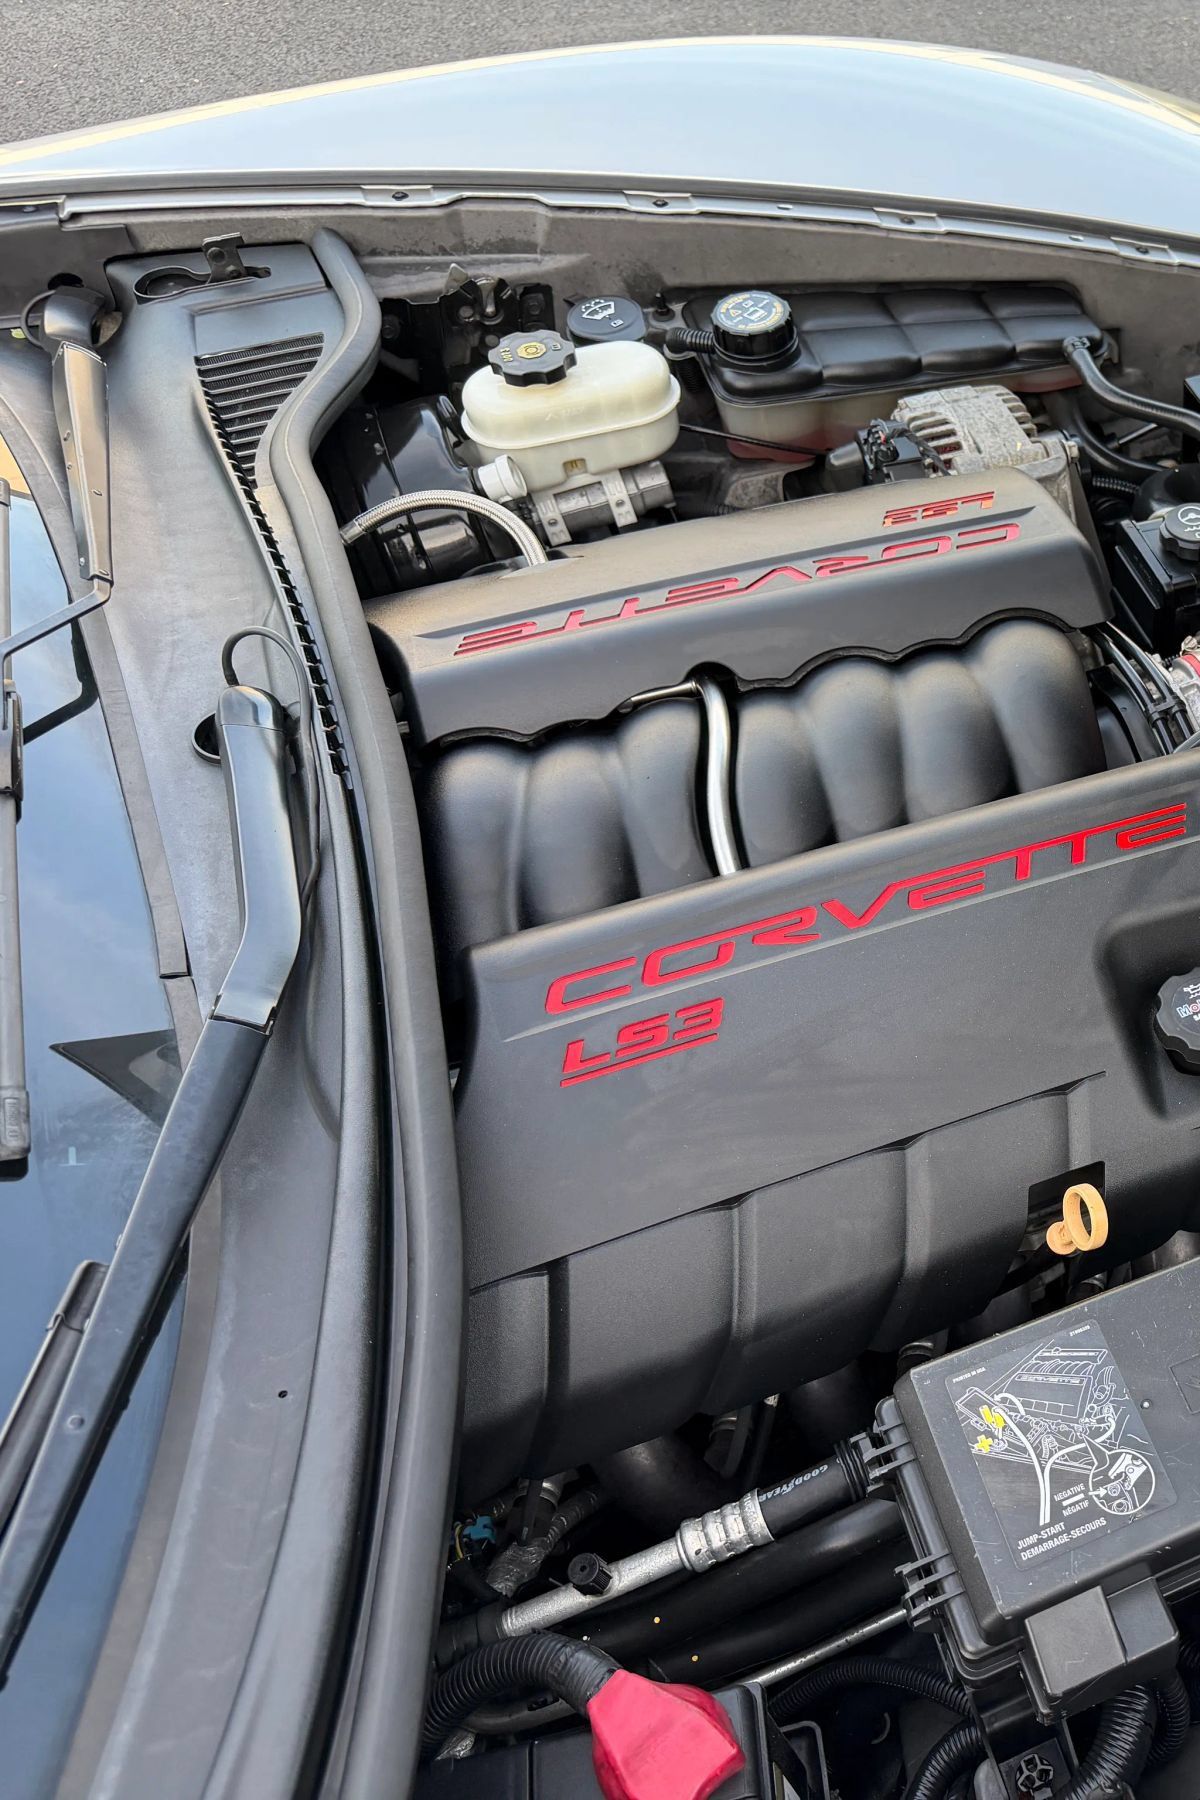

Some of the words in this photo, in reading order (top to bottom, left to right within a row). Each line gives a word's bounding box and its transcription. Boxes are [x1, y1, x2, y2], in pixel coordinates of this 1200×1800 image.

[882, 491, 995, 528] LS3
[453, 522, 1021, 657] CORVETTE
[545, 803, 1188, 1014] CORVETTE
[561, 997, 725, 1078] LS3
[758, 1464, 829, 1502] GOODYEAR
[1053, 1483, 1085, 1501] NEGATIVE
[1062, 1499, 1089, 1517] NÉGATIF
[1017, 1521, 1066, 1550] JUMP-START
[1020, 1517, 1107, 1561] DEMARRAGE-SECOURS
